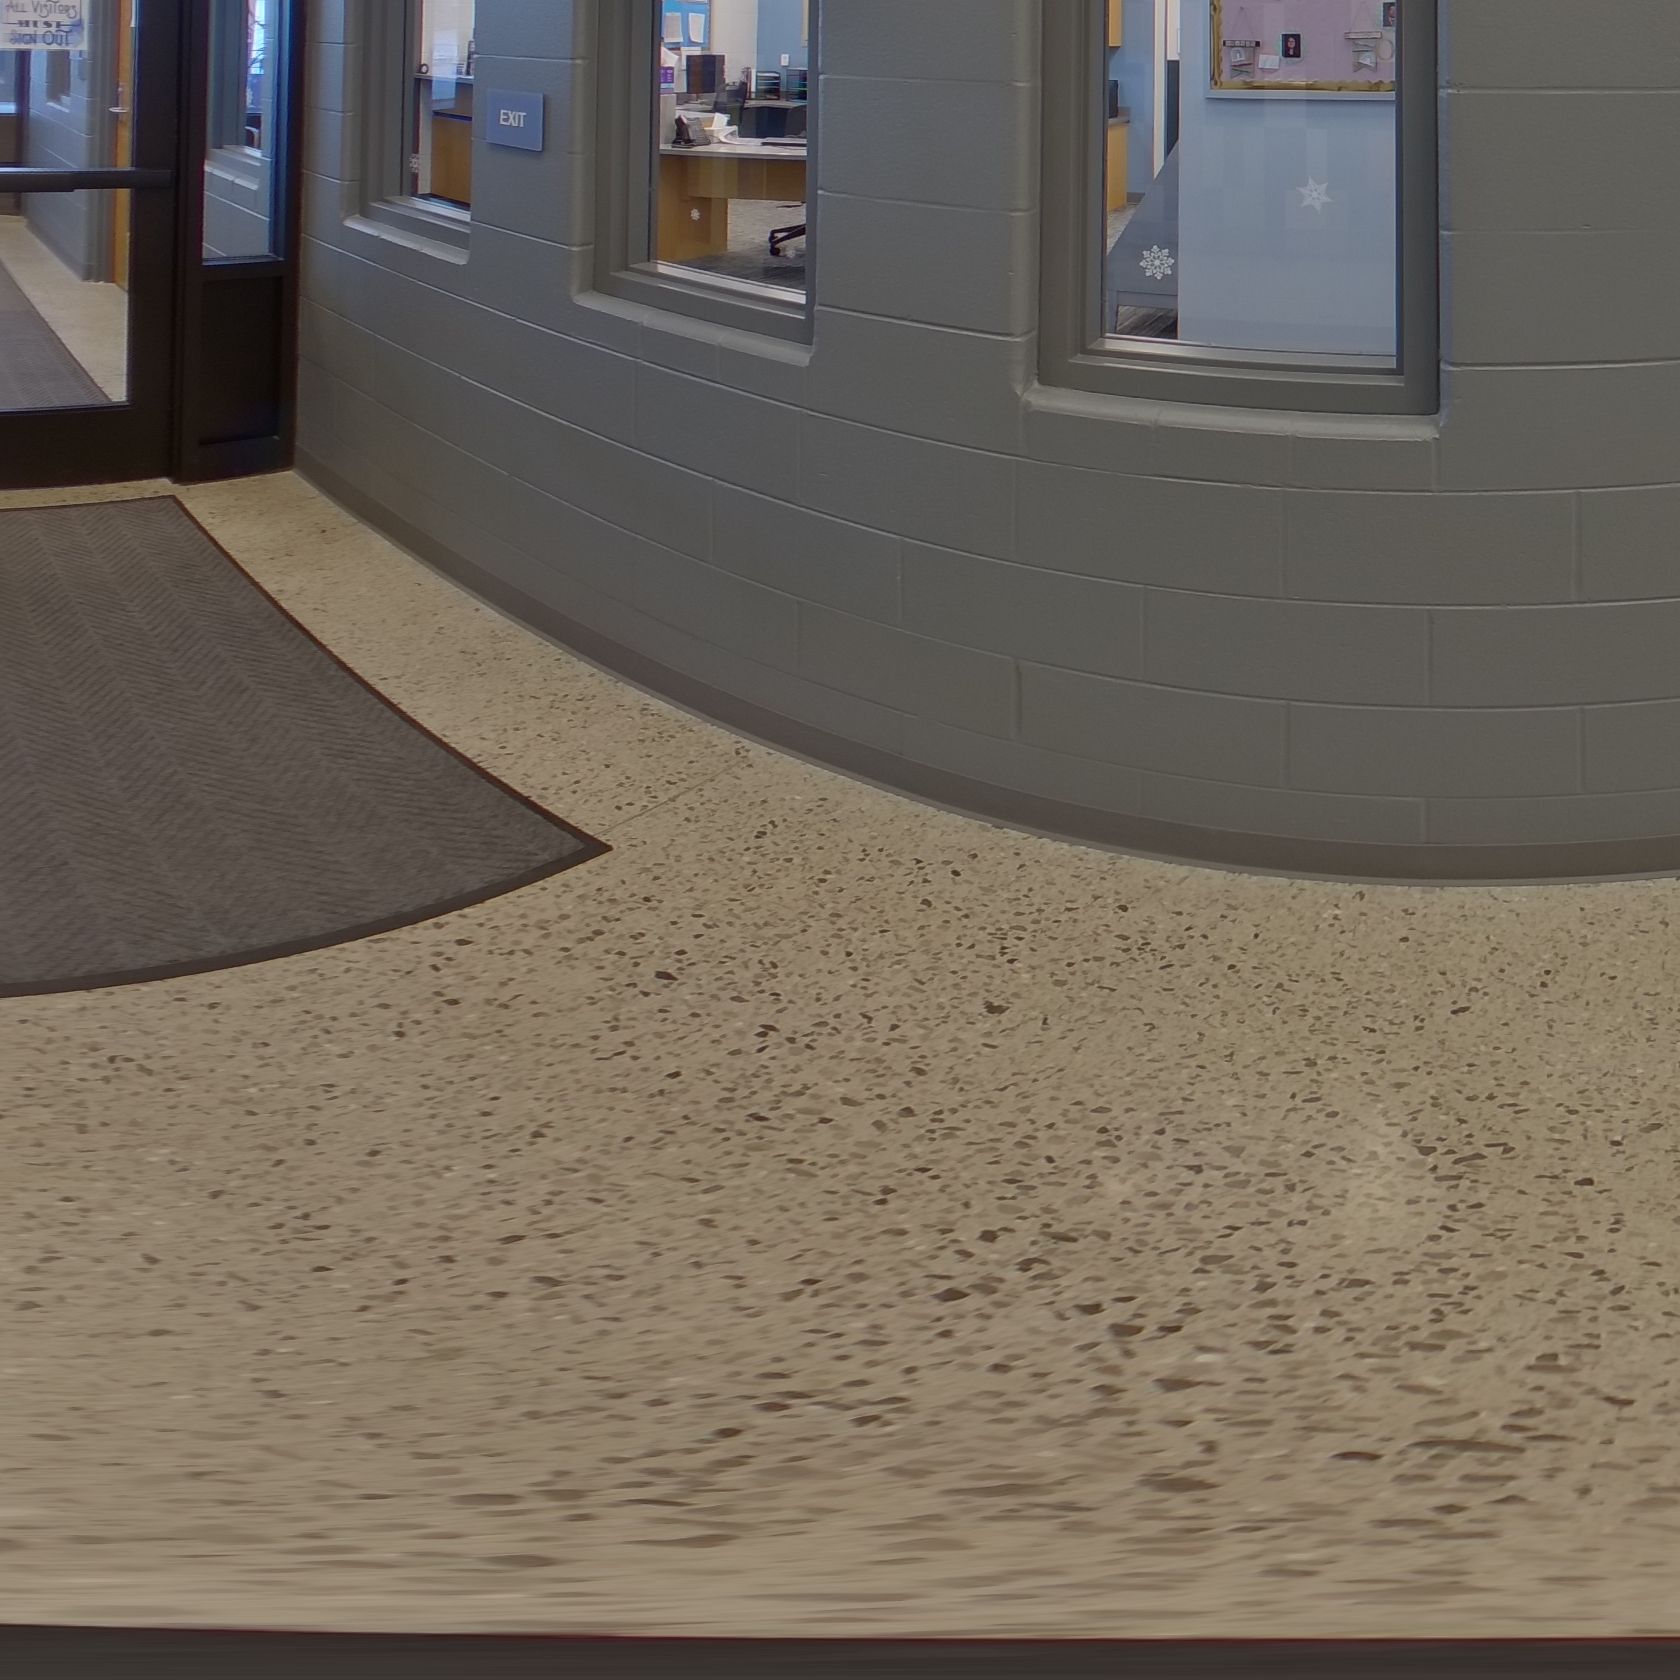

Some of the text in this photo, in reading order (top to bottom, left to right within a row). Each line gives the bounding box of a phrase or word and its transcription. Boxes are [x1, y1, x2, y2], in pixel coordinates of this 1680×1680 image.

[5, 0, 77, 19] ALL VISITORS
[42, 29, 72, 46] OUT
[500, 109, 527, 127] EXIT
